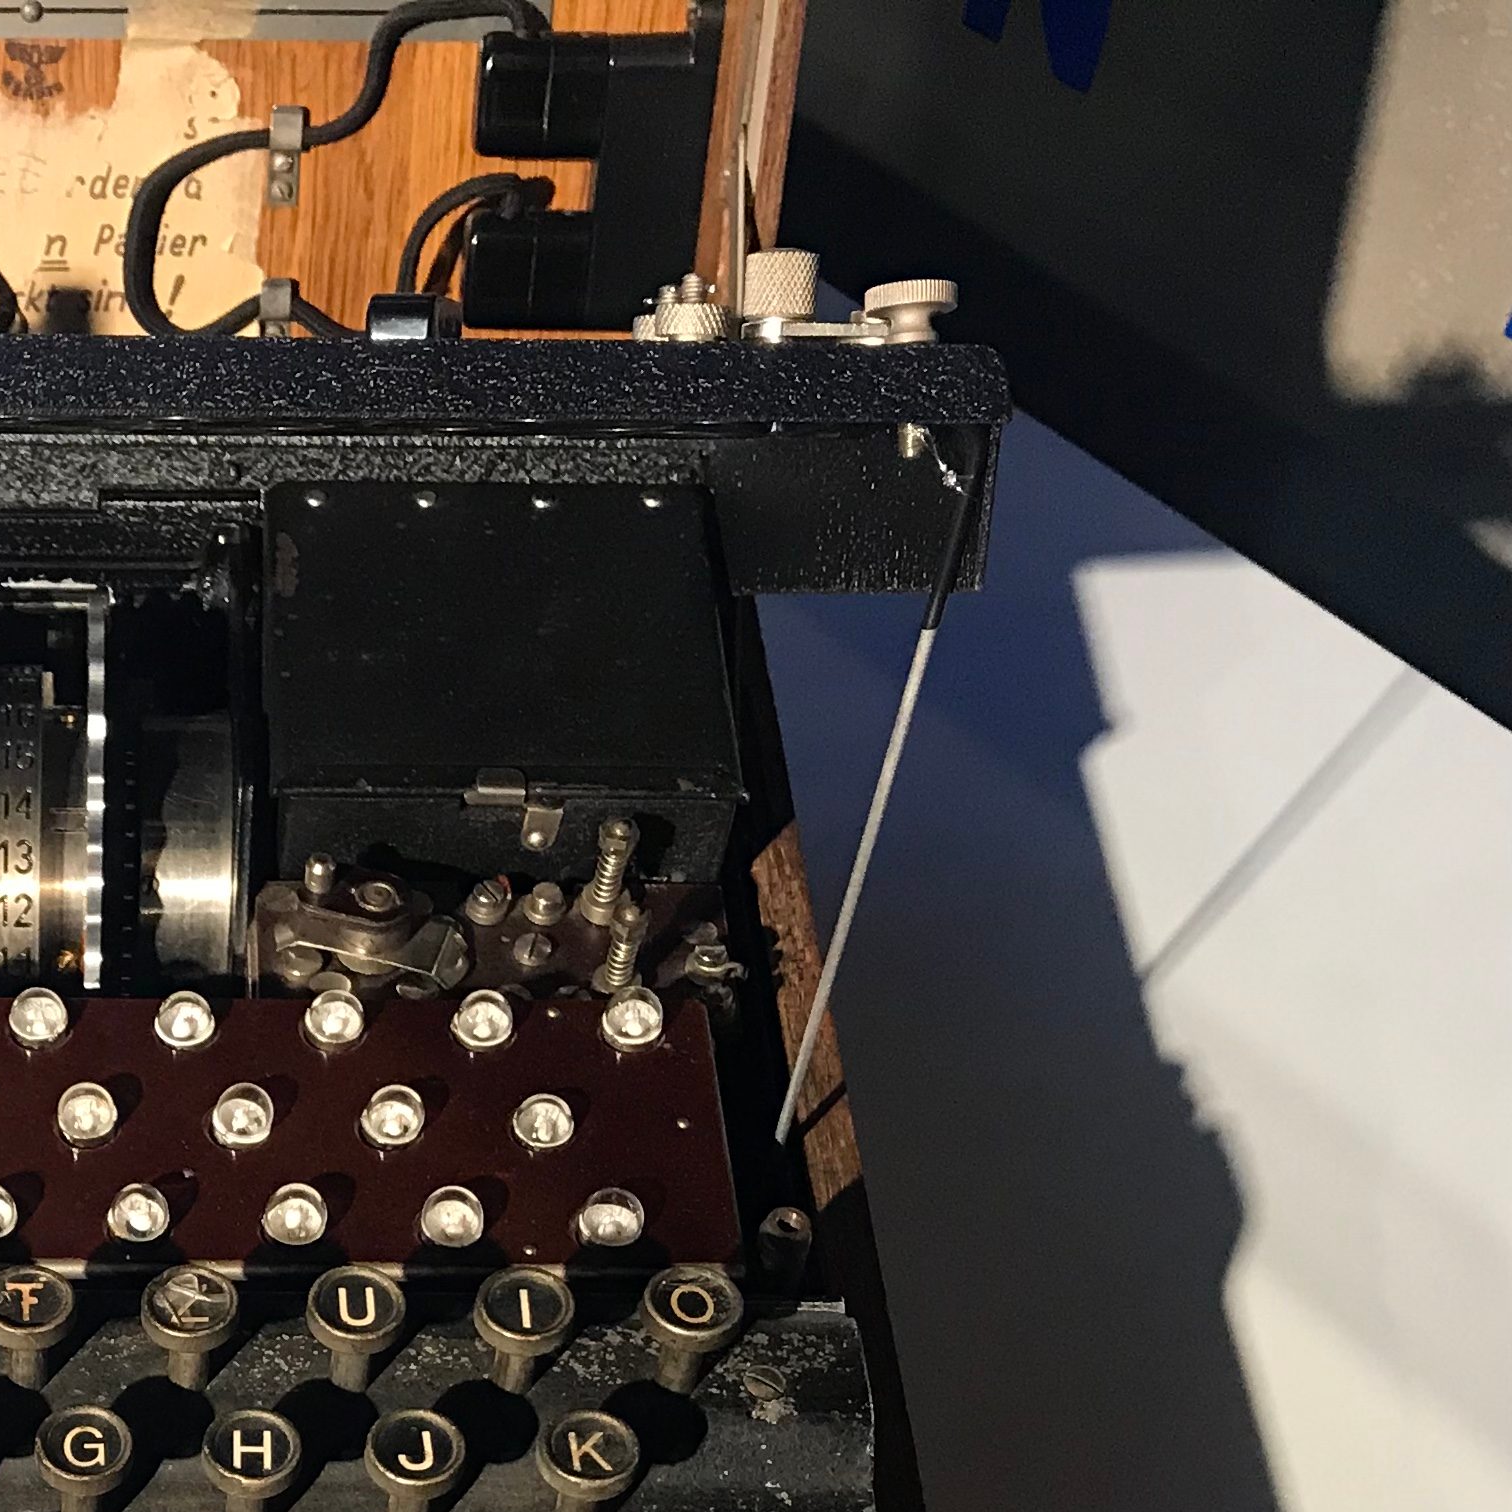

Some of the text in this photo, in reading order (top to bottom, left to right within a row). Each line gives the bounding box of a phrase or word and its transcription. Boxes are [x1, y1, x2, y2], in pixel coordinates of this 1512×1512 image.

[93, 222, 208, 257] Paier
[0, 786, 33, 821] 14
[337, 1286, 376, 1327] U
[518, 1288, 532, 1329] I
[670, 1283, 717, 1324] O
[63, 1426, 106, 1468] G
[232, 1429, 272, 1471] H
[397, 1430, 434, 1471] J
[567, 1431, 614, 1472] K
